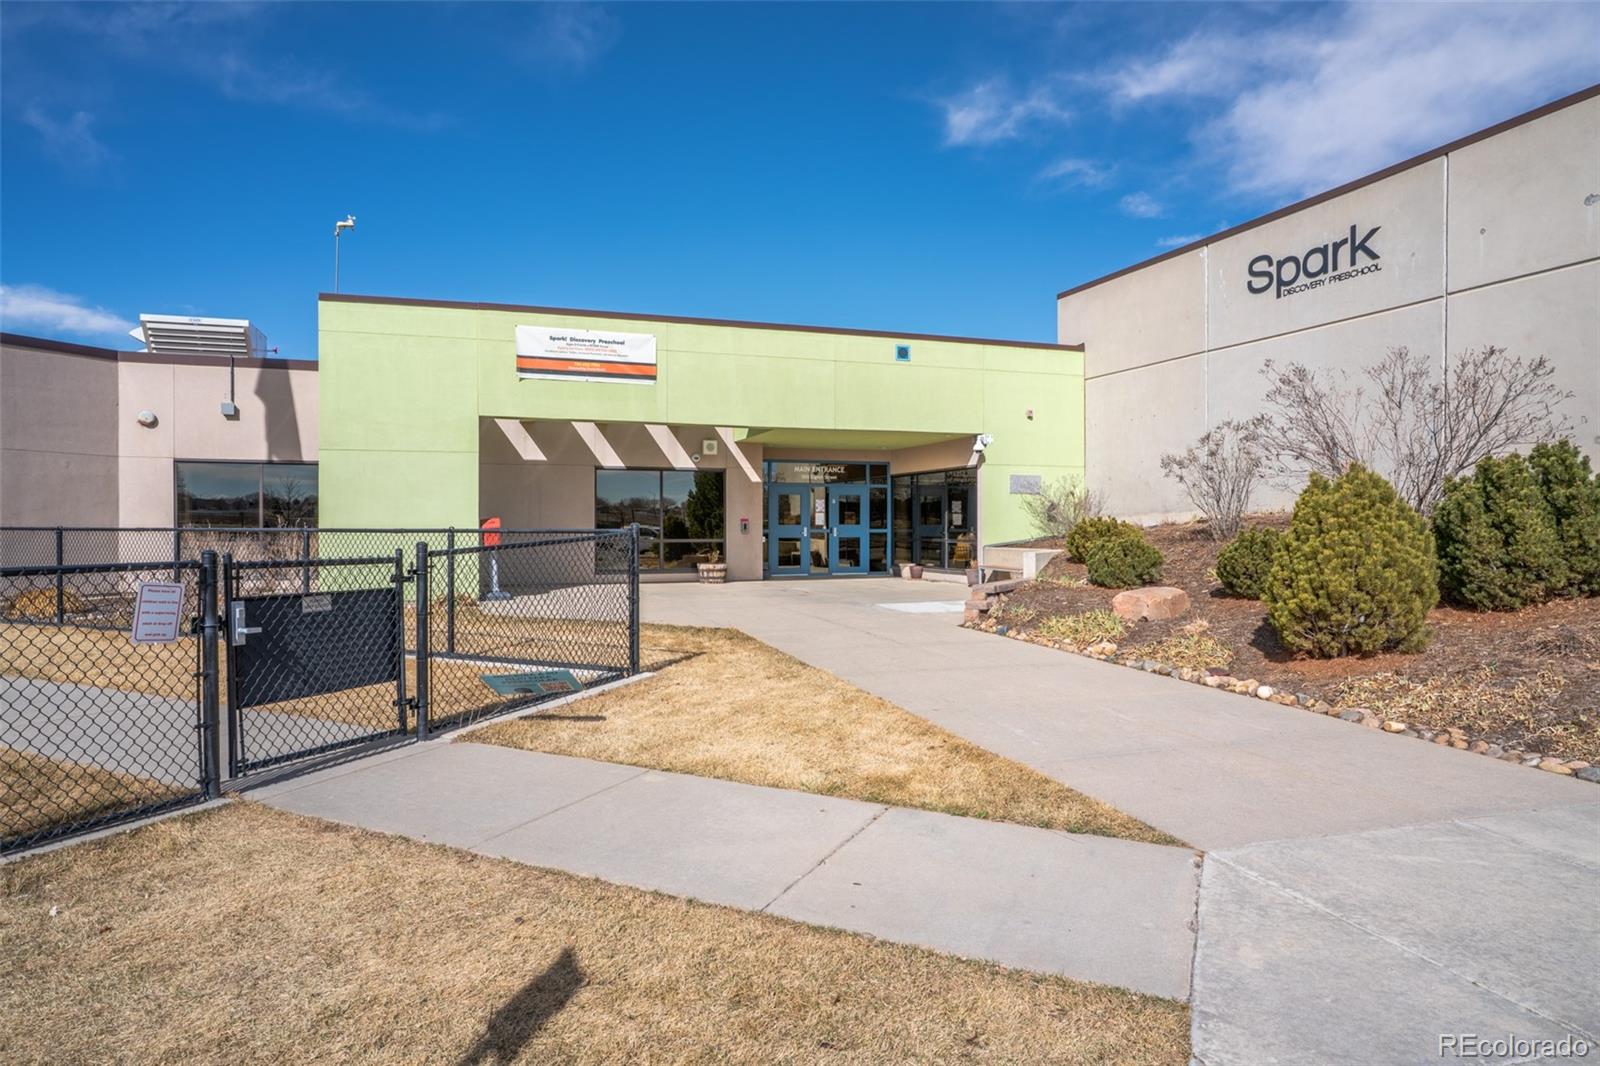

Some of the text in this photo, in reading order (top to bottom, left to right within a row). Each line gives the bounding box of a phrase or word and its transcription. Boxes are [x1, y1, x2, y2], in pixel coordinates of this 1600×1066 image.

[1247, 224, 1381, 299] Spark
[1283, 263, 1382, 297] DISCOVERY PRESCHOOL
[570, 336, 596, 344] Discovery
[794, 465, 845, 473] MAIN ENTRANCE
